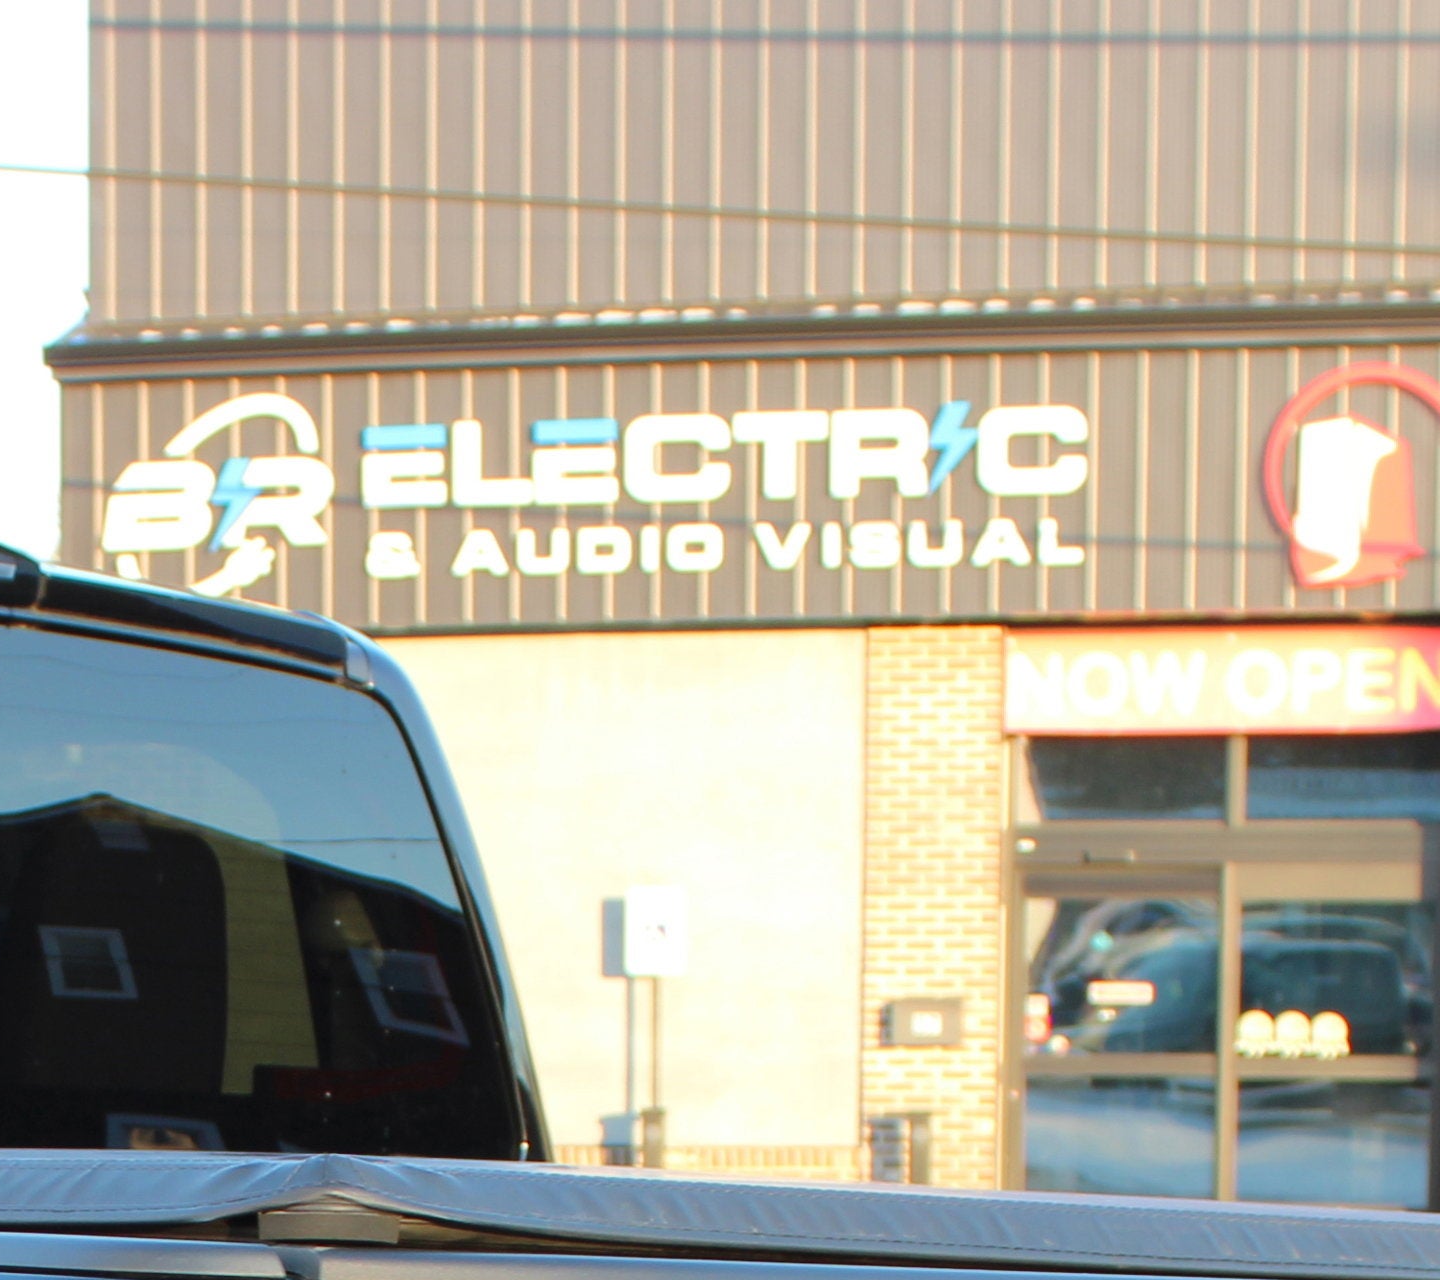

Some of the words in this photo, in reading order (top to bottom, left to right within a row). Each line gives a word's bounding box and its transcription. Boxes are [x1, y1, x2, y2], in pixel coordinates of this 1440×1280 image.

[365, 530, 421, 579] &
[451, 522, 725, 577] AUDIO
[753, 517, 1086, 571] VISUAL
[1007, 648, 1208, 718] NOW
